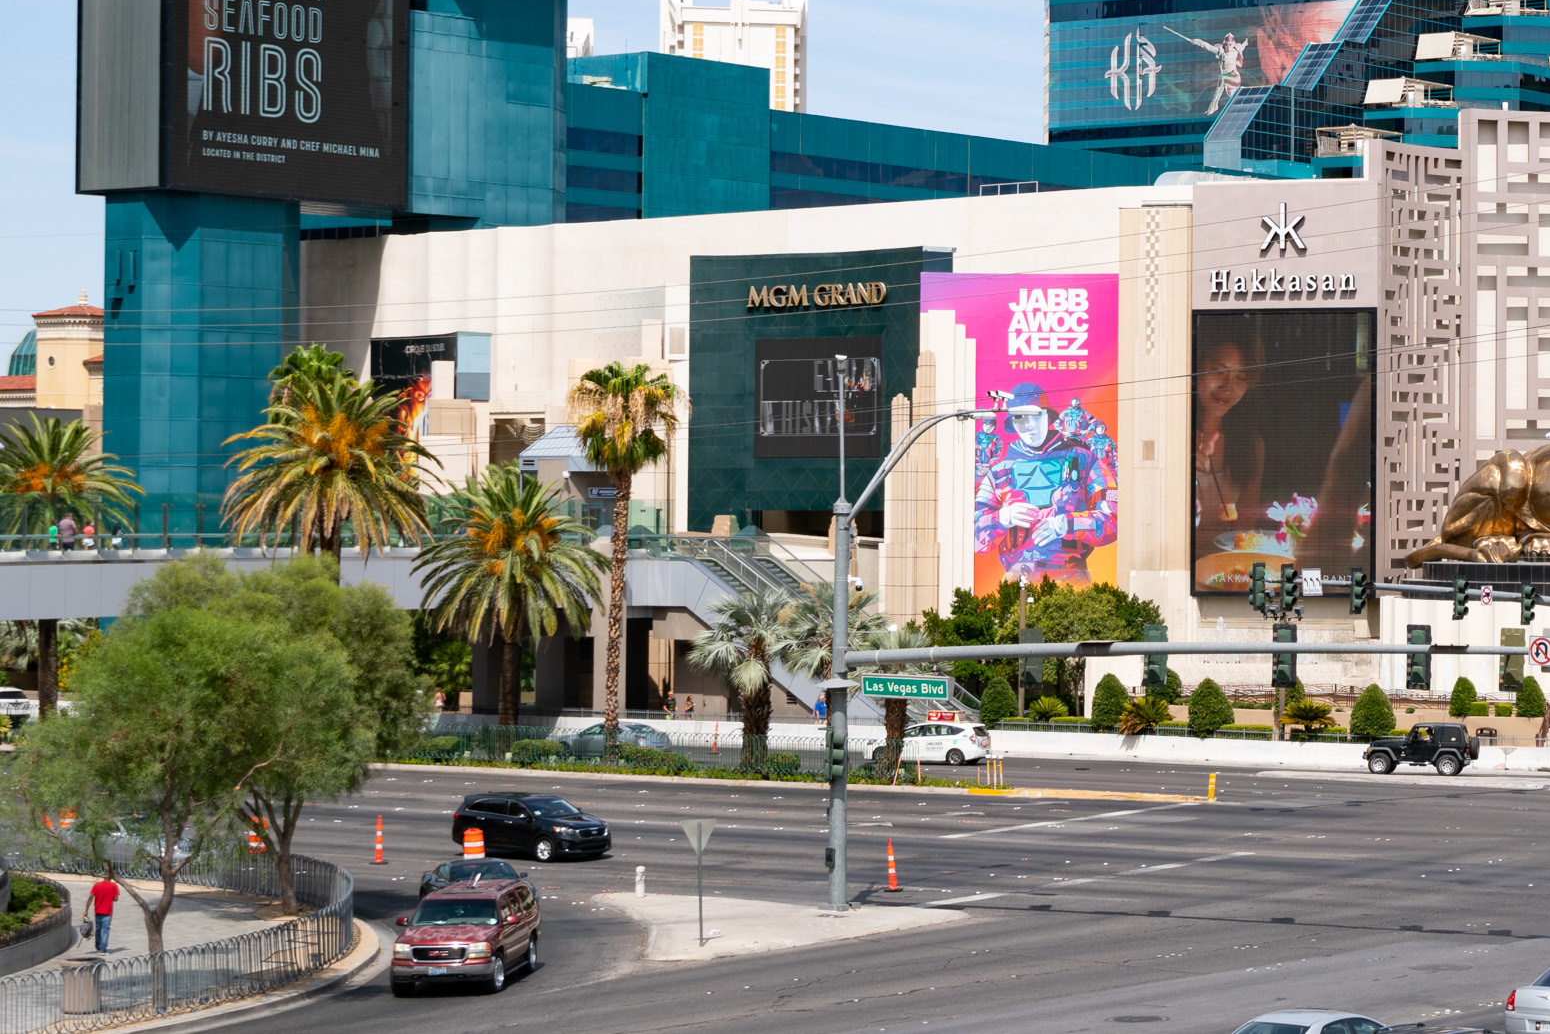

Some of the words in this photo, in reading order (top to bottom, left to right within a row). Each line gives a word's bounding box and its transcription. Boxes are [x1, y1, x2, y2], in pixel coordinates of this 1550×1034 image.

[203, 37, 321, 123] RIBS
[203, 130, 214, 141] BY
[216, 131, 249, 145] AYESHA
[251, 135, 278, 148] CURRY
[281, 138, 298, 150] AND
[300, 140, 321, 152] CHEF
[323, 143, 357, 156] MICHAEL
[359, 147, 380, 159] MINA
[203, 147, 231, 159] LOCATED
[233, 150, 241, 160] IN
[242, 151, 255, 161] THE
[256, 153, 286, 164] DISTRICT
[1209, 268, 1357, 293] Hakkasan
[746, 284, 810, 308] MGM
[813, 281, 887, 307] GRAND
[1008, 288, 1089, 312] JABB
[1008, 311, 1089, 332] AWOC
[1008, 332, 1088, 355] KEEZ
[1009, 360, 1088, 370] TIMELESS
[865, 681, 884, 692] Las
[887, 682, 917, 696] Vegas
[921, 683, 944, 695] Blvd
